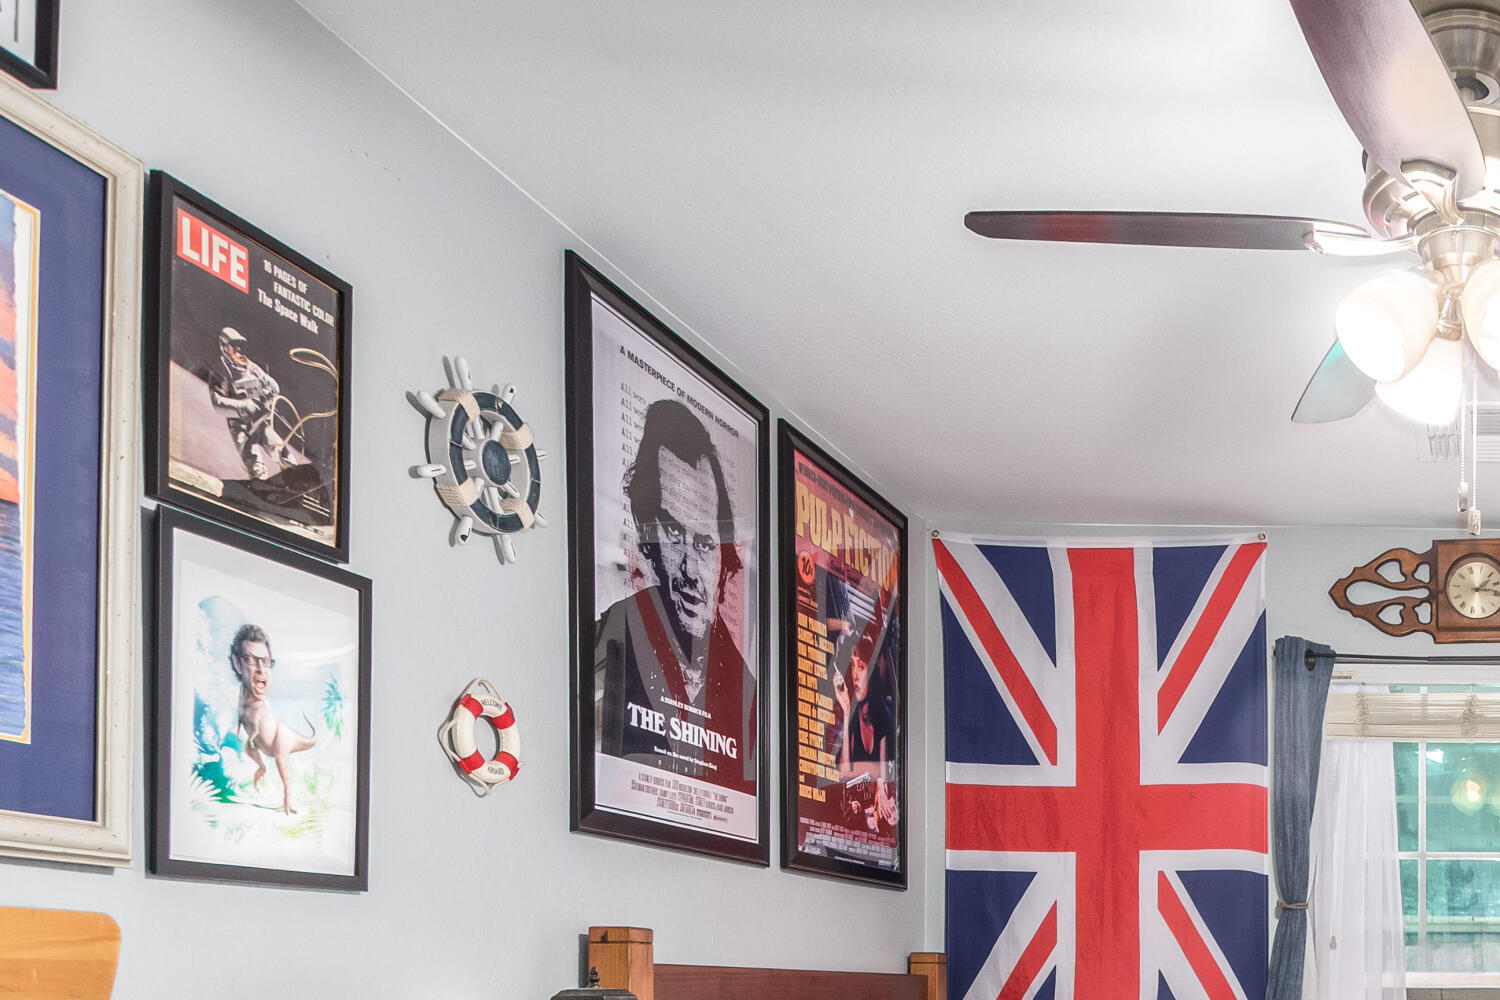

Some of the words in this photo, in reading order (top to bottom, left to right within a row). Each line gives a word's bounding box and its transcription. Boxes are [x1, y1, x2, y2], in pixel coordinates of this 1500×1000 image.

[182, 215, 247, 289] LIFE
[273, 265, 296, 287] PAGES
[298, 280, 308, 294] OF
[257, 288, 273, 309] The
[274, 298, 298, 323] Space
[300, 312, 319, 335] Walk
[273, 281, 311, 313] FANTASTIC
[312, 305, 335, 328] COLOR
[620, 345, 625, 356] A
[627, 350, 676, 392] MASTERPIECE
[676, 387, 686, 398] OF
[687, 395, 714, 420] MODERN
[715, 415, 739, 439] HORROR
[795, 480, 842, 558] PULP
[627, 702, 666, 737] THE
[669, 716, 738, 759] SHINING
